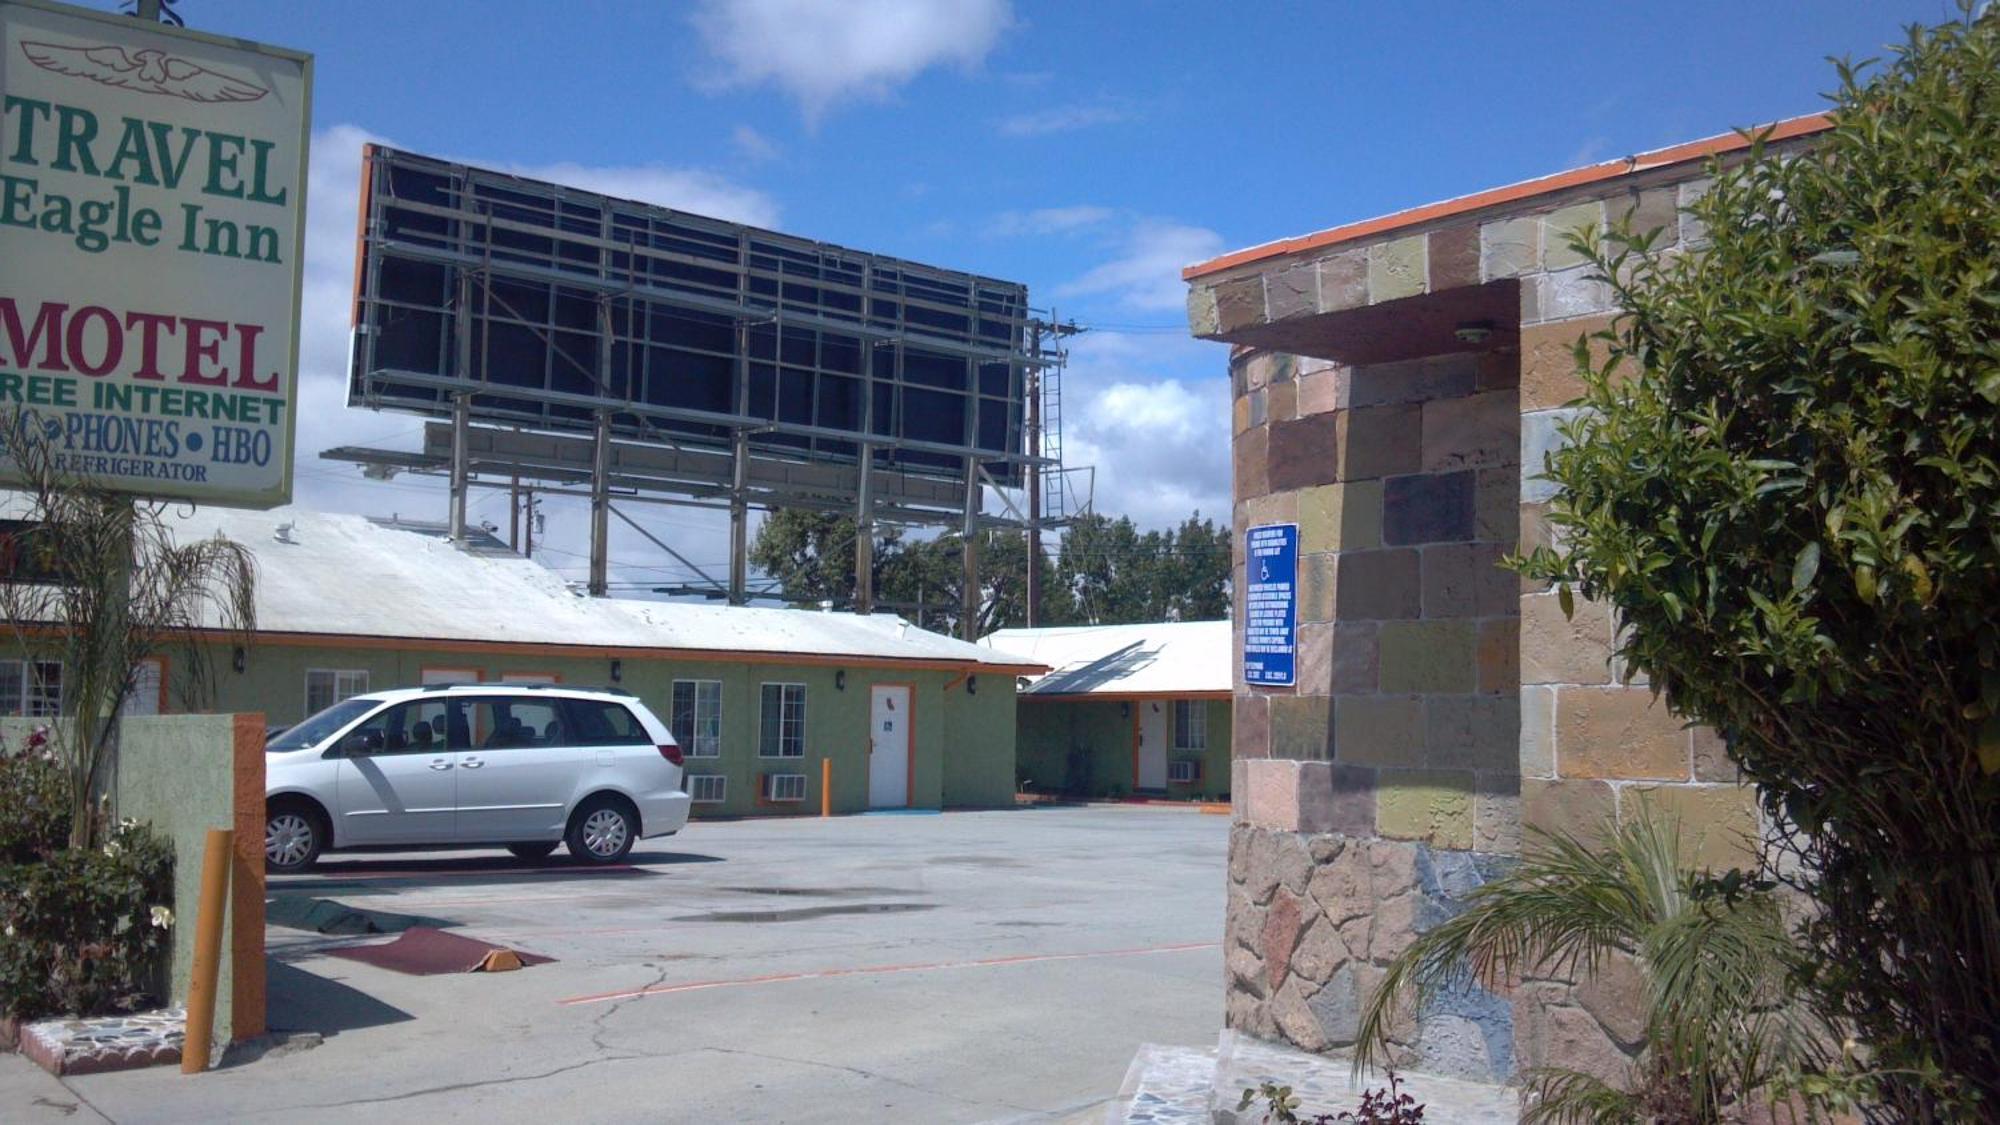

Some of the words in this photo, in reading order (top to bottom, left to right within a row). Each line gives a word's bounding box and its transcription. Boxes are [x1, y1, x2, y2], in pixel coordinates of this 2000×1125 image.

[4, 94, 287, 207] TRAVEL
[0, 174, 163, 253] Eagle
[177, 203, 283, 264] Inn
[0, 297, 279, 393] MOTEL
[93, 381, 286, 425] INTERNET
[55, 453, 208, 482] REFRIGERATOR
[64, 412, 180, 459] PHONES
[210, 426, 271, 467] HBO
